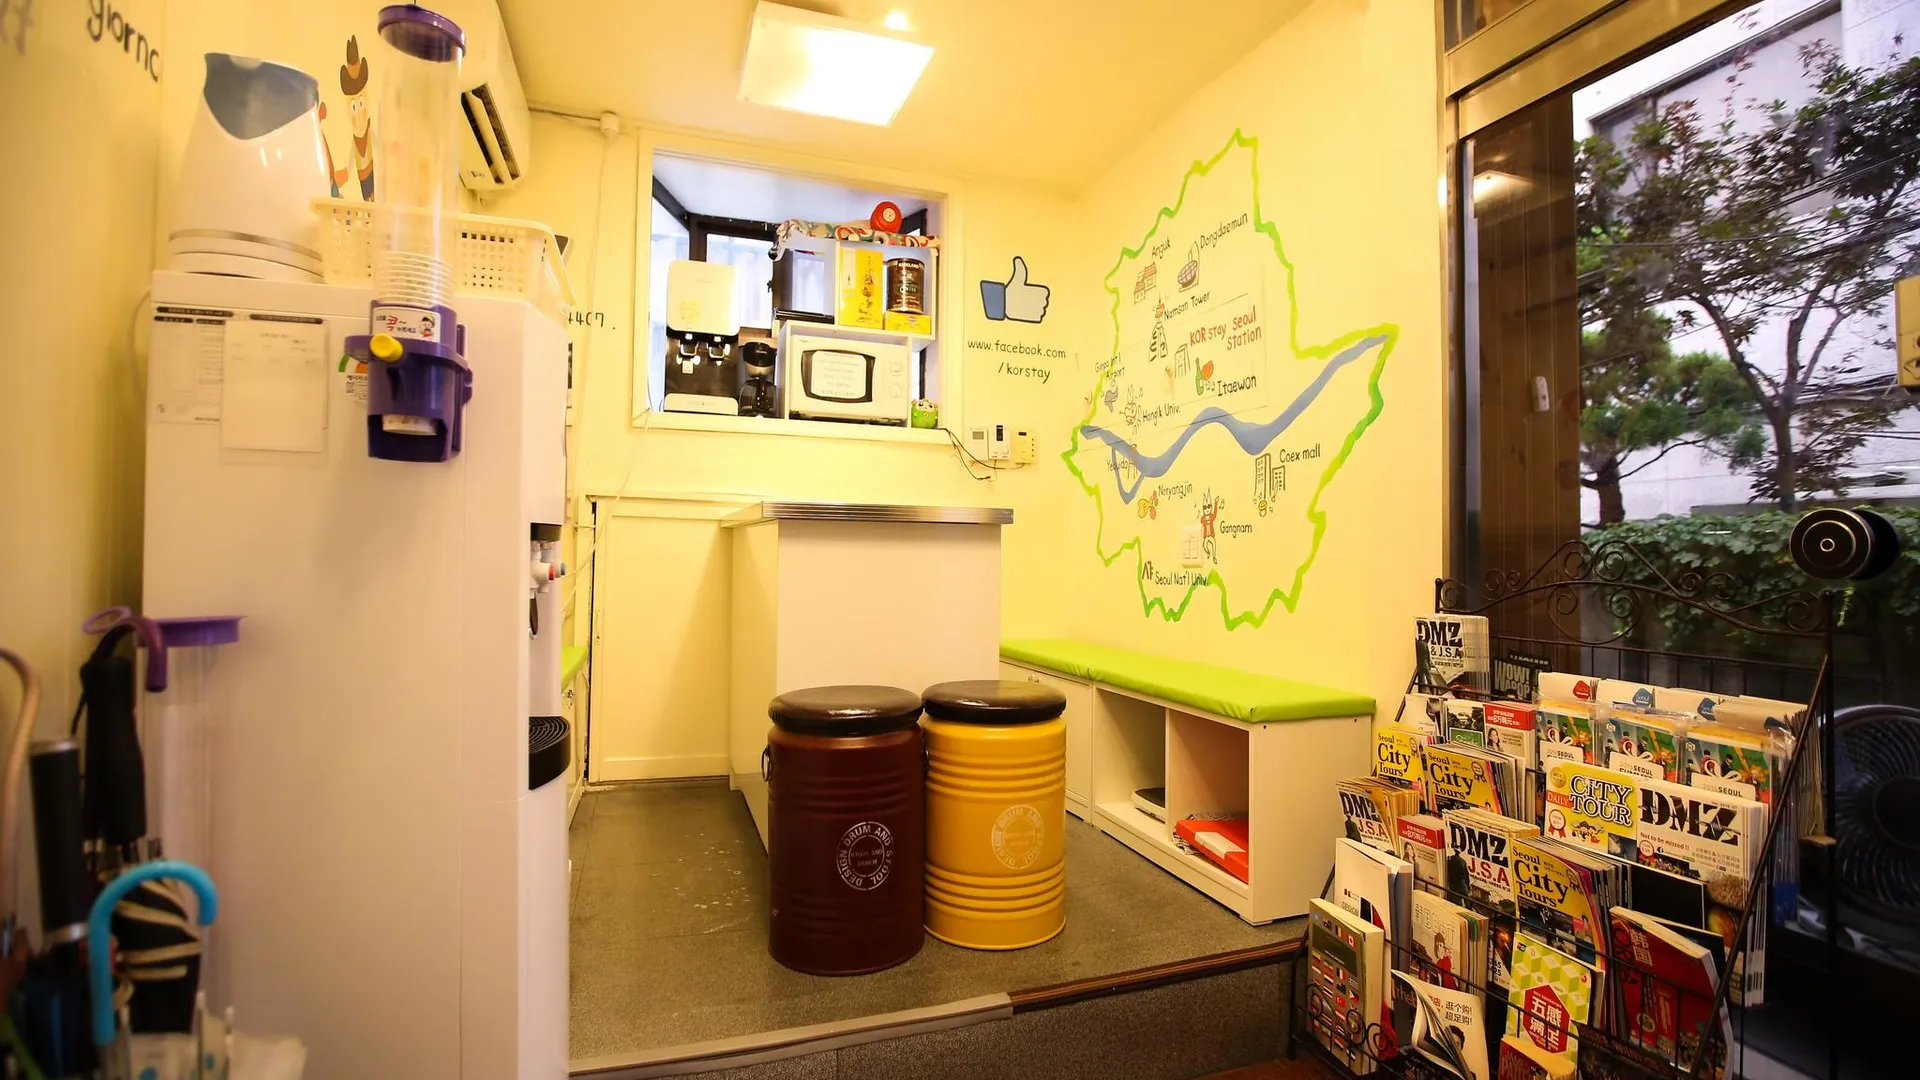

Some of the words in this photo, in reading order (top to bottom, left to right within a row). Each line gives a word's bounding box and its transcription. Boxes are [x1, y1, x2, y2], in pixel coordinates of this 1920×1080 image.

[1200, 213, 1248, 249] Dongdaemun
[1151, 236, 1171, 259] Anguk
[1164, 301, 1189, 320] Namsan
[1190, 292, 1211, 307] Tower
[1189, 327, 1207, 347] KOR
[1208, 324, 1226, 340] stay
[968, 339, 1066, 359] www.facebook.com
[1217, 375, 1257, 397] Itaewon
[1280, 448, 1301, 463] Coex
[1302, 443, 1321, 460] mall
[1220, 520, 1253, 539] Gangnam
[1155, 571, 1173, 585] Seoul
[1416, 619, 1463, 648] DMZ
[1494, 659, 1530, 691] WOW!
[1377, 732, 1395, 744] Seoul
[1377, 743, 1411, 773] City
[1378, 761, 1404, 778] Tours
[1427, 751, 1450, 765] Seoul
[1430, 762, 1474, 795] City
[1432, 781, 1466, 800] Tours
[1547, 792, 1570, 806] DAILY
[1339, 790, 1383, 824] DMZ
[1570, 794, 1632, 826] TOUR
[1639, 788, 1739, 847] DMZ
[843, 824, 871, 847] DRUM
[873, 827, 891, 846] AND
[1358, 818, 1388, 839] J.S.A
[1450, 821, 1509, 868] DMZ
[1640, 832, 1651, 840] Not
[1665, 839, 1685, 850] missed
[870, 850, 893, 885] STOOL
[1512, 846, 1541, 866] Seoul
[839, 849, 863, 887] DESIGN
[1467, 857, 1511, 887] J.S.A
[1513, 859, 1569, 904] City
[1515, 880, 1557, 908] Tours
